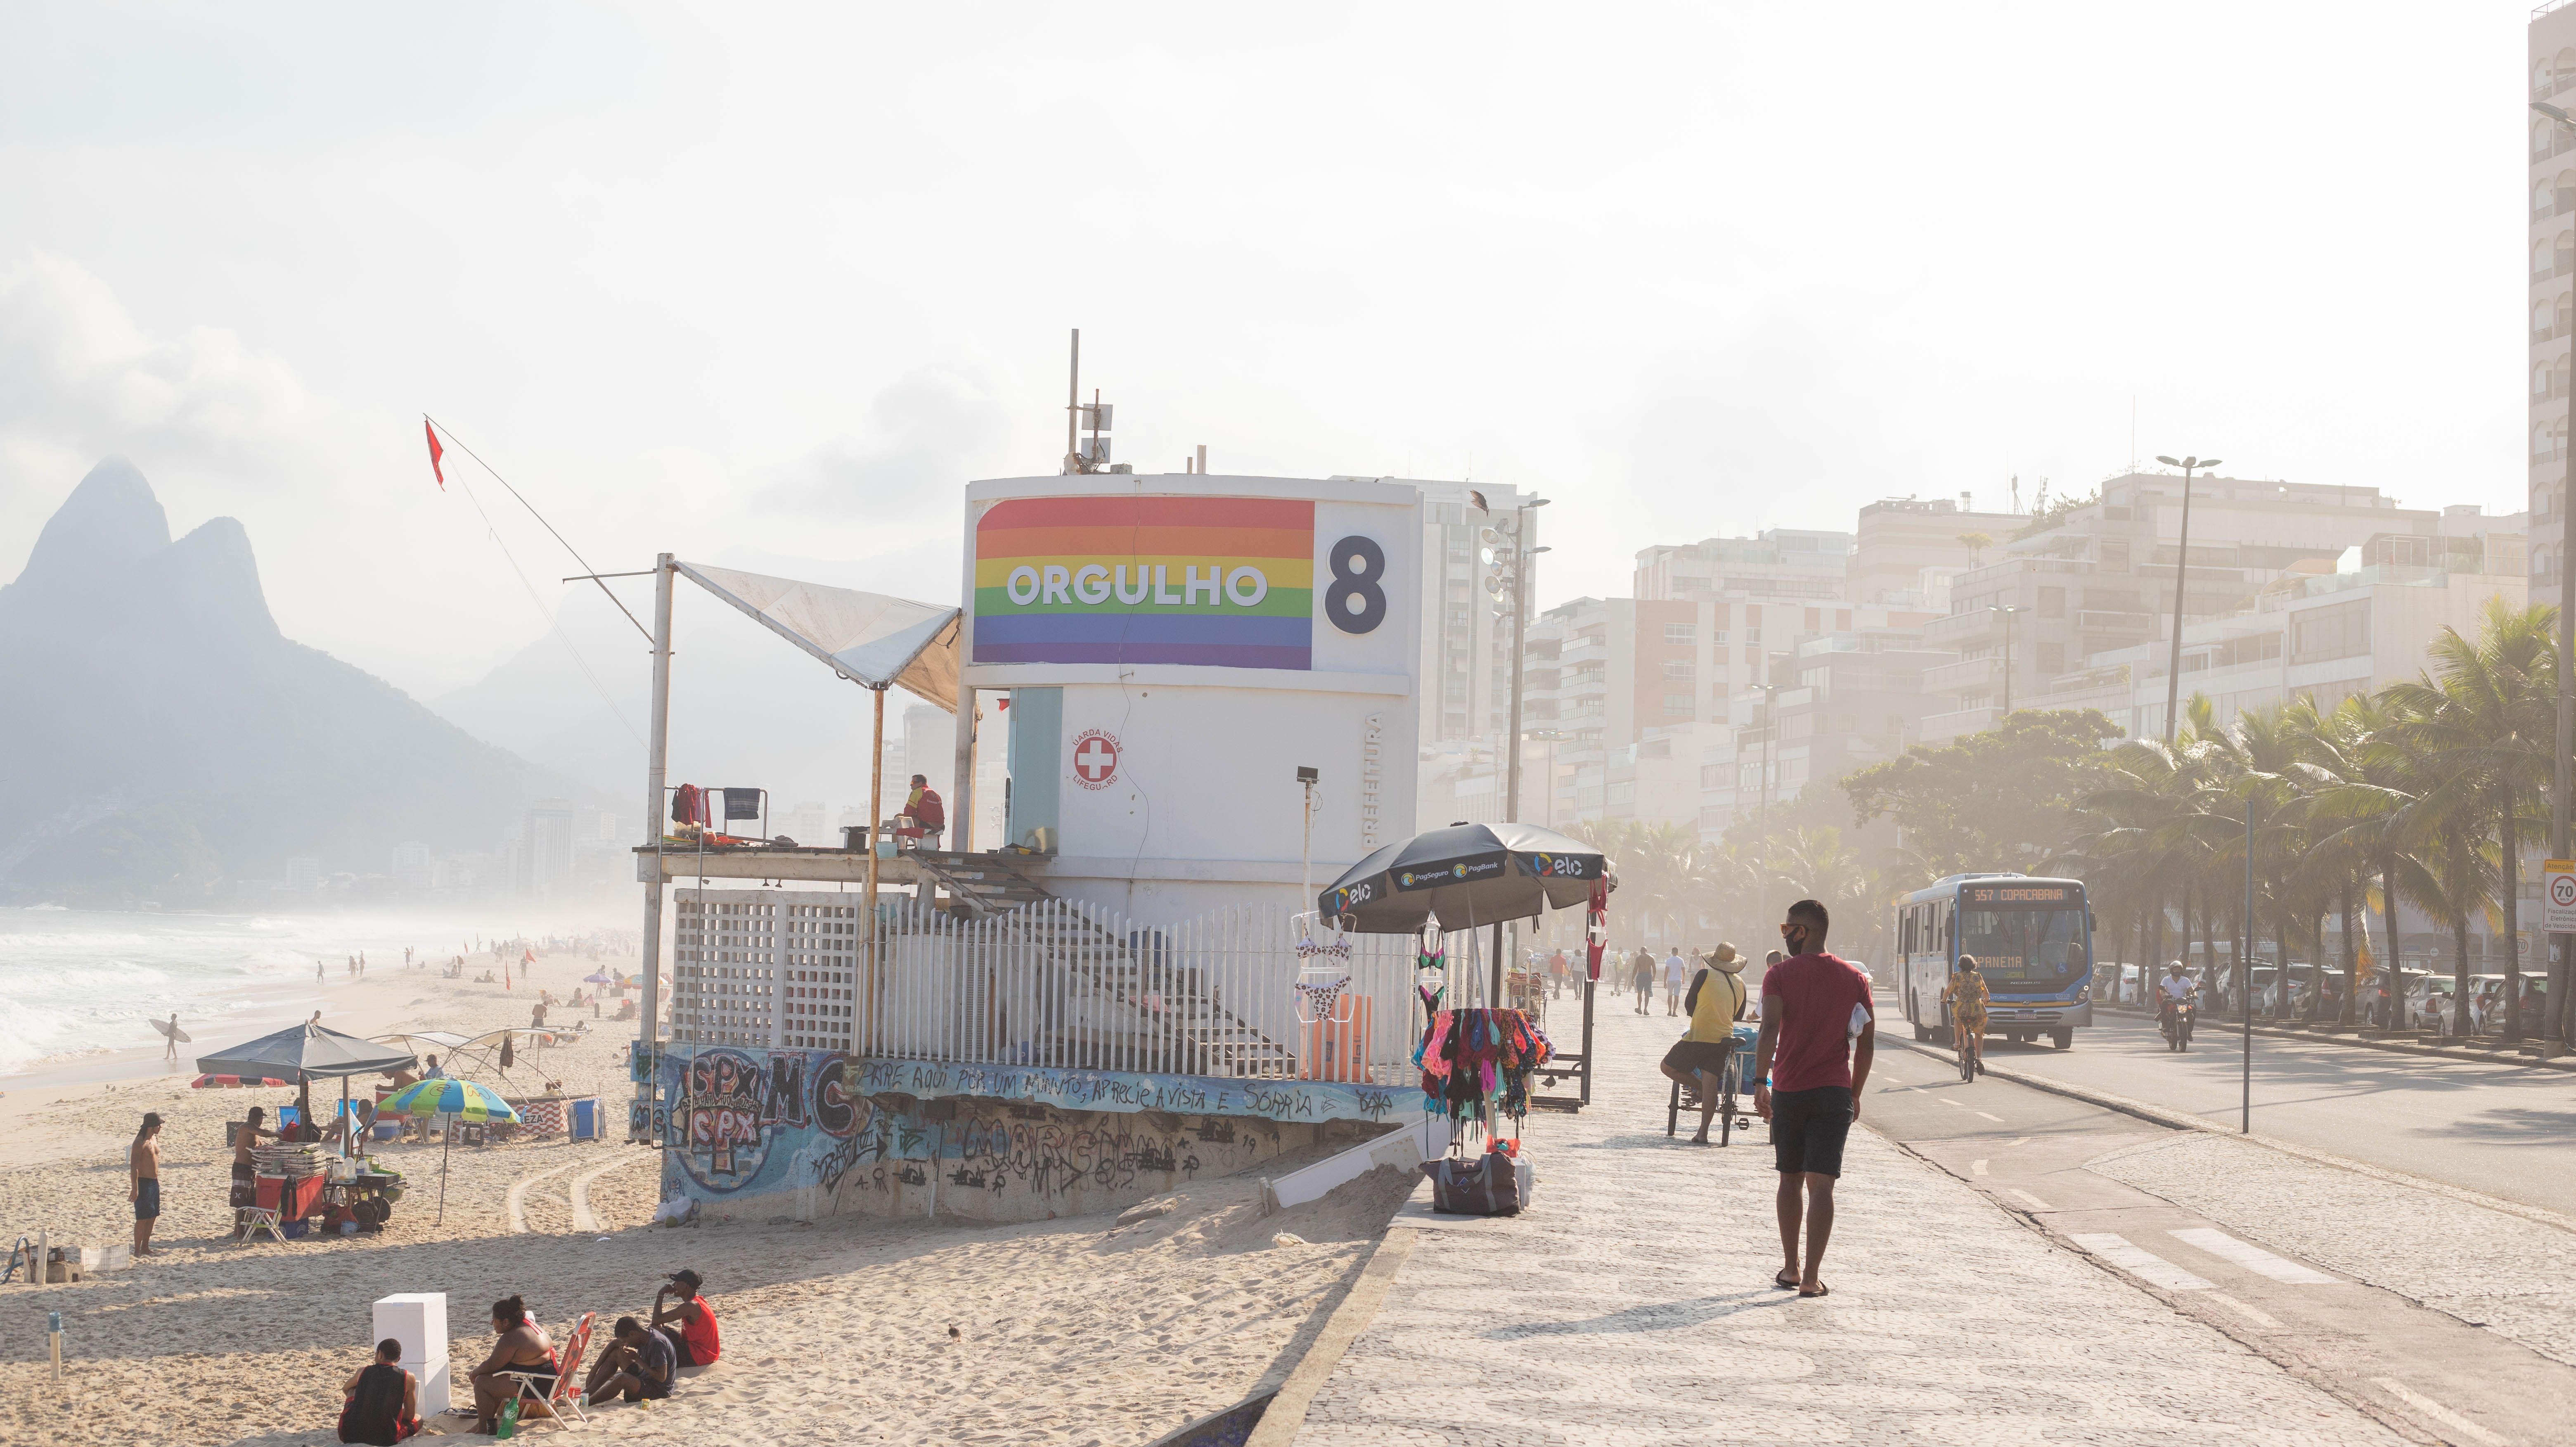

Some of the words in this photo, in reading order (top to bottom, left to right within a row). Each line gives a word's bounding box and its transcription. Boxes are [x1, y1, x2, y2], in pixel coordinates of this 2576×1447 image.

[1007, 564, 1268, 607] ORGULHO
[1323, 535, 1387, 635] 8
[1103, 730, 1123, 753] VIDAS
[1362, 712, 1382, 850] PREFEITURA
[1415, 870, 1449, 881] PagSeguro
[1468, 862, 1498, 873] PagBank
[1554, 856, 1582, 875] elo
[1350, 883, 1371, 904] elo
[1975, 889, 1994, 901] 557
[2001, 889, 2063, 901] COPACABANA
[2556, 885, 2574, 898] 70
[1975, 956, 2022, 968] PANEMA
[857, 1062, 904, 1089] PARE
[956, 1069, 985, 1093] POR
[994, 1072, 1016, 1096] UM
[1155, 1086, 1165, 1108] A
[1217, 1091, 1229, 1110] E
